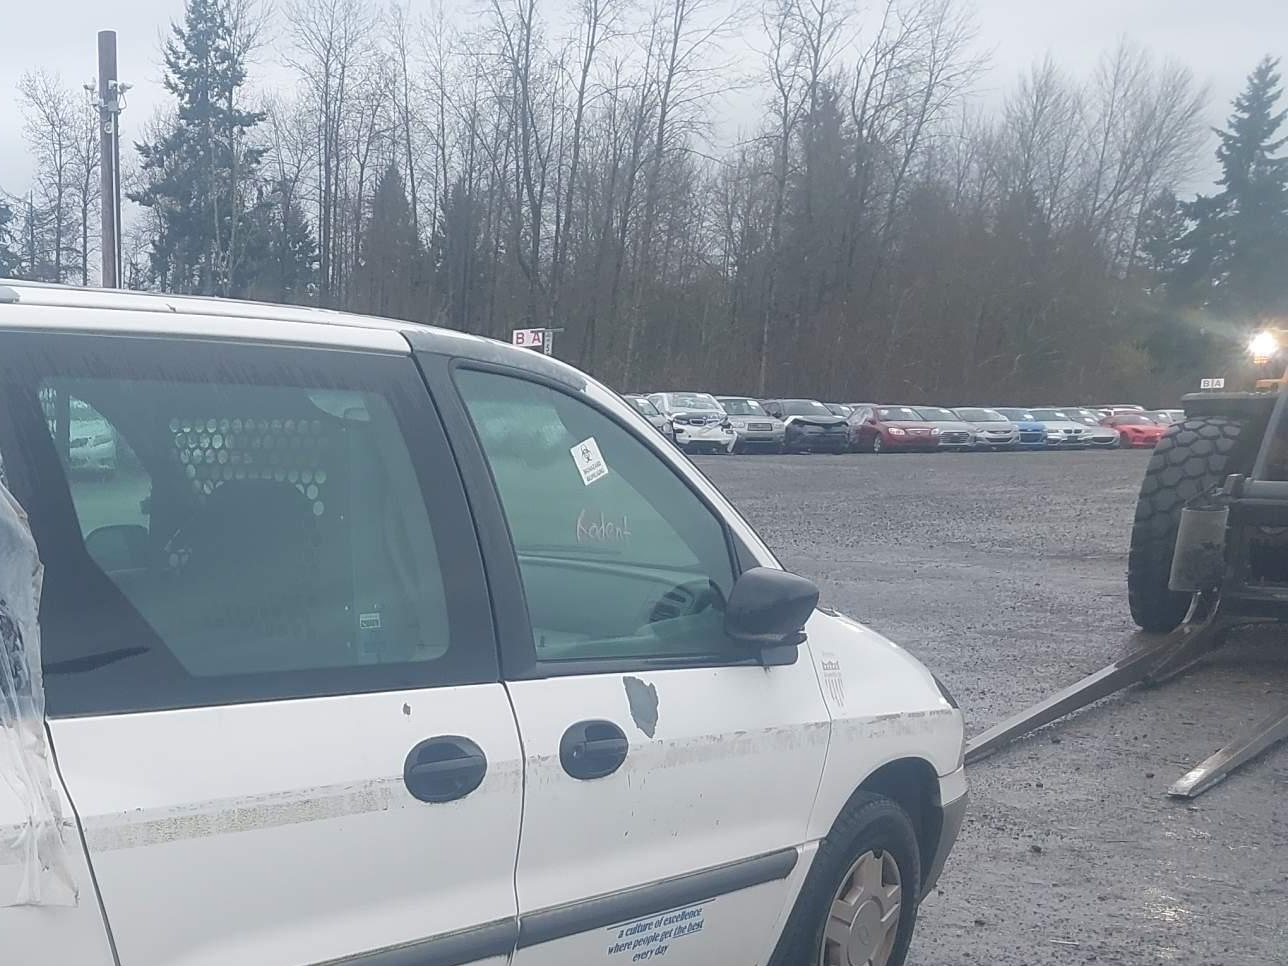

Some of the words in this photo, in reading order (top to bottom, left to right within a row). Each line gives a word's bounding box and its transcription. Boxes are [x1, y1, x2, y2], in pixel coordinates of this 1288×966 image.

[516, 332, 525, 345] B
[531, 331, 541, 344] A
[617, 930, 624, 939] a
[625, 921, 653, 937] culture
[654, 916, 665, 929] of
[664, 907, 703, 926] excellence
[608, 941, 633, 955] where
[632, 932, 660, 950] people
[659, 928, 673, 943] get
[673, 923, 687, 937] the
[687, 918, 705, 933] best
[632, 948, 653, 962] every
[654, 944, 669, 956] day
